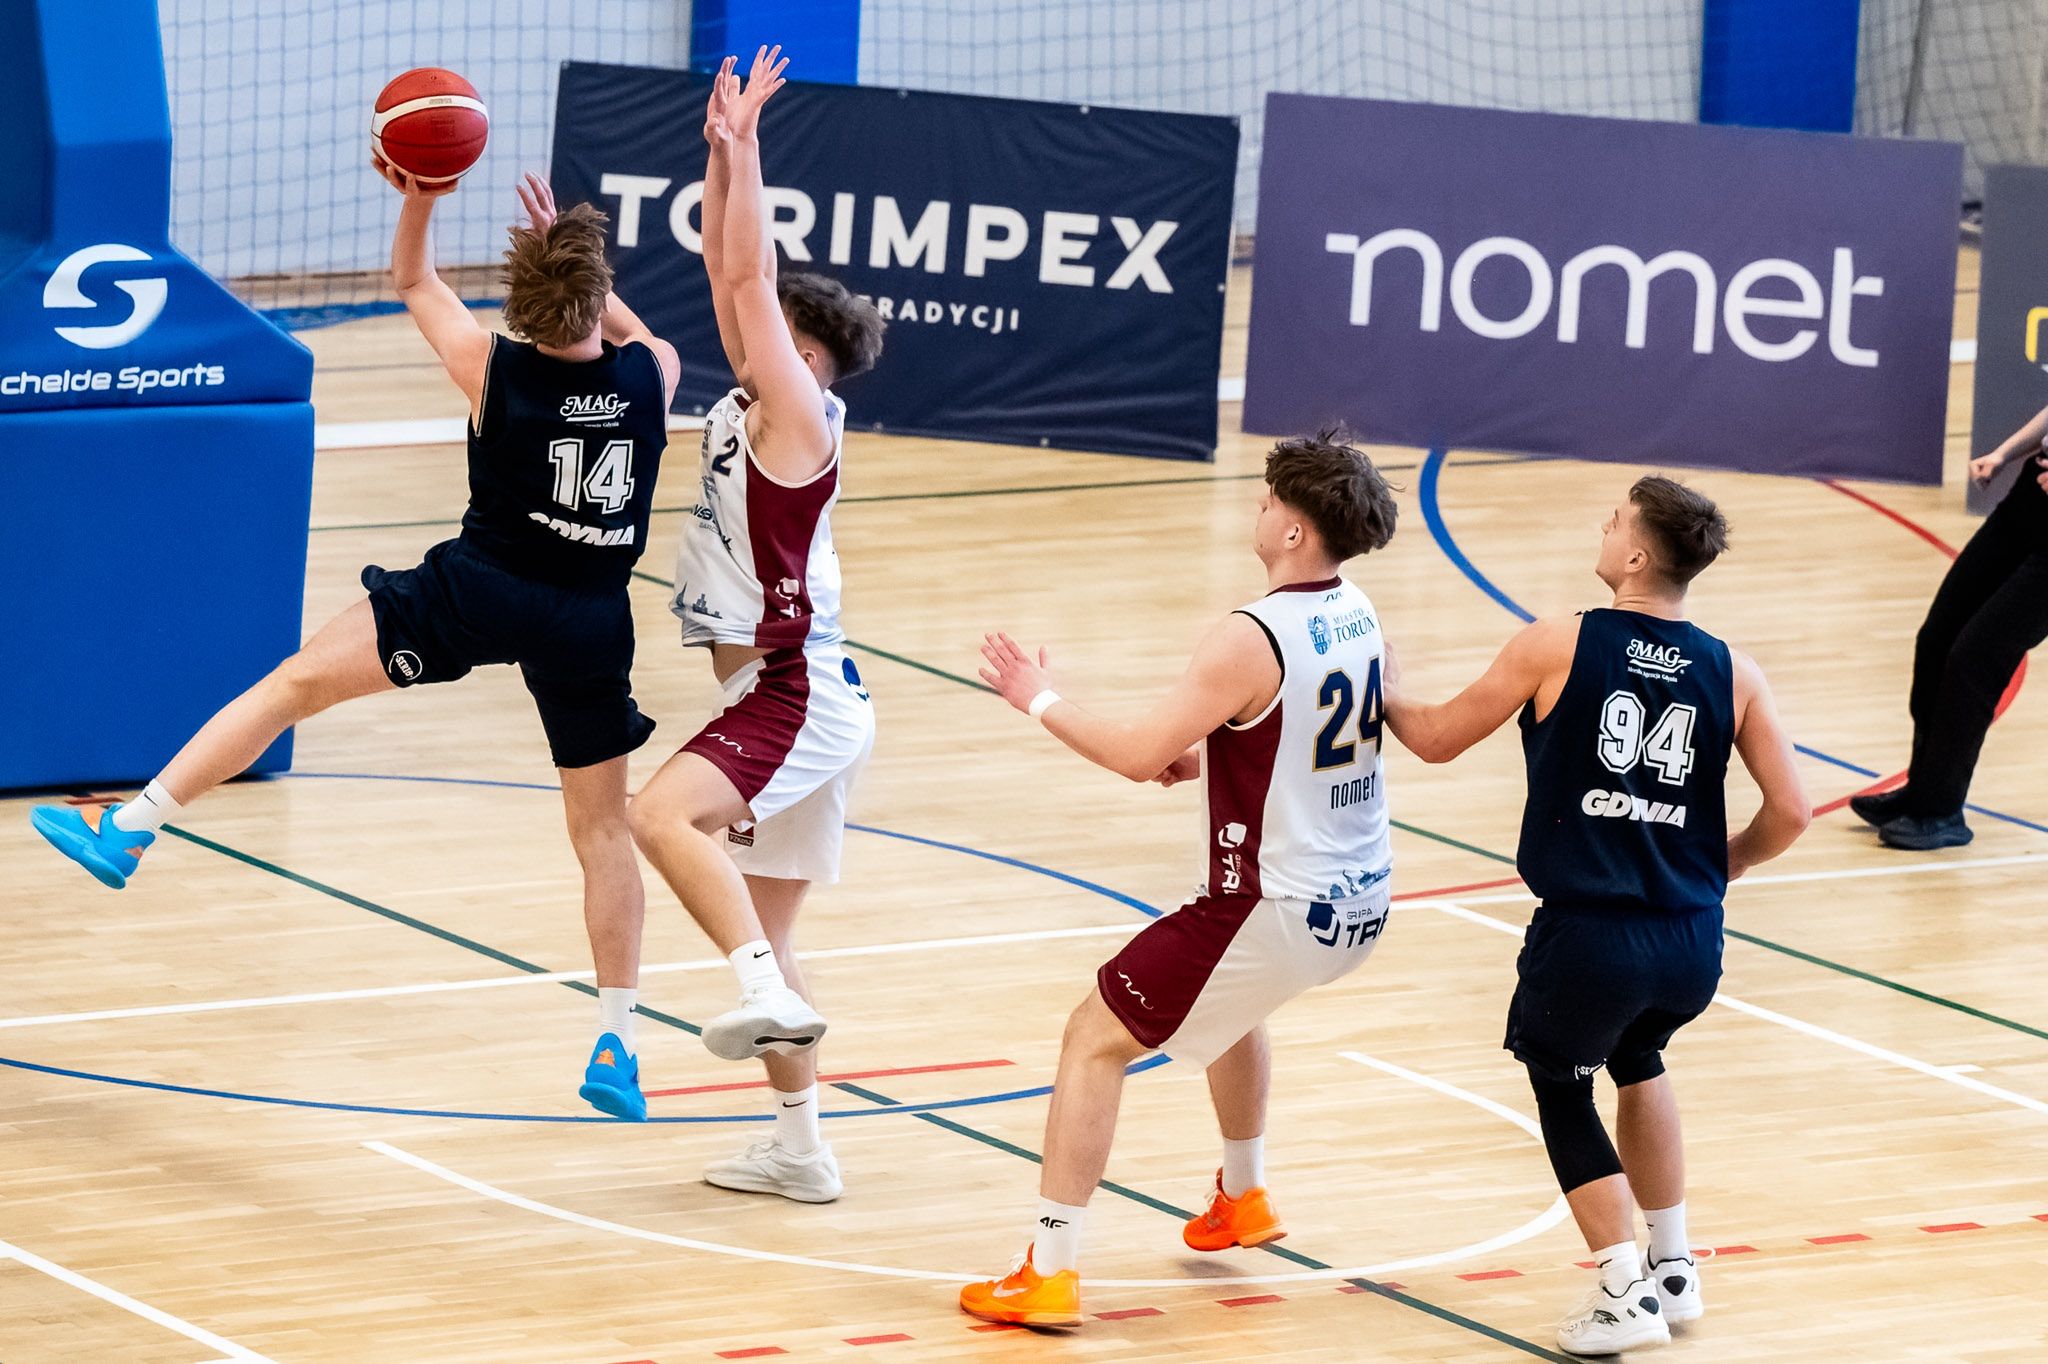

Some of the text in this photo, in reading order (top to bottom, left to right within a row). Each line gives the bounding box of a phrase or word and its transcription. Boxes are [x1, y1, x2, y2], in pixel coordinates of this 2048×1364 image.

[858, 295, 1020, 334] RADYCJI
[1325, 228, 1885, 368] nomet
[0, 363, 225, 395] chelde Sports
[560, 393, 624, 419] MAG
[548, 438, 635, 515] 14
[1333, 608, 1364, 625] MIASTO
[1626, 638, 1686, 668] MAG
[1312, 654, 1384, 772] 24
[1597, 689, 1697, 786] 94
[1330, 771, 1376, 809] nomet
[1581, 788, 1687, 829] GDYNIA
